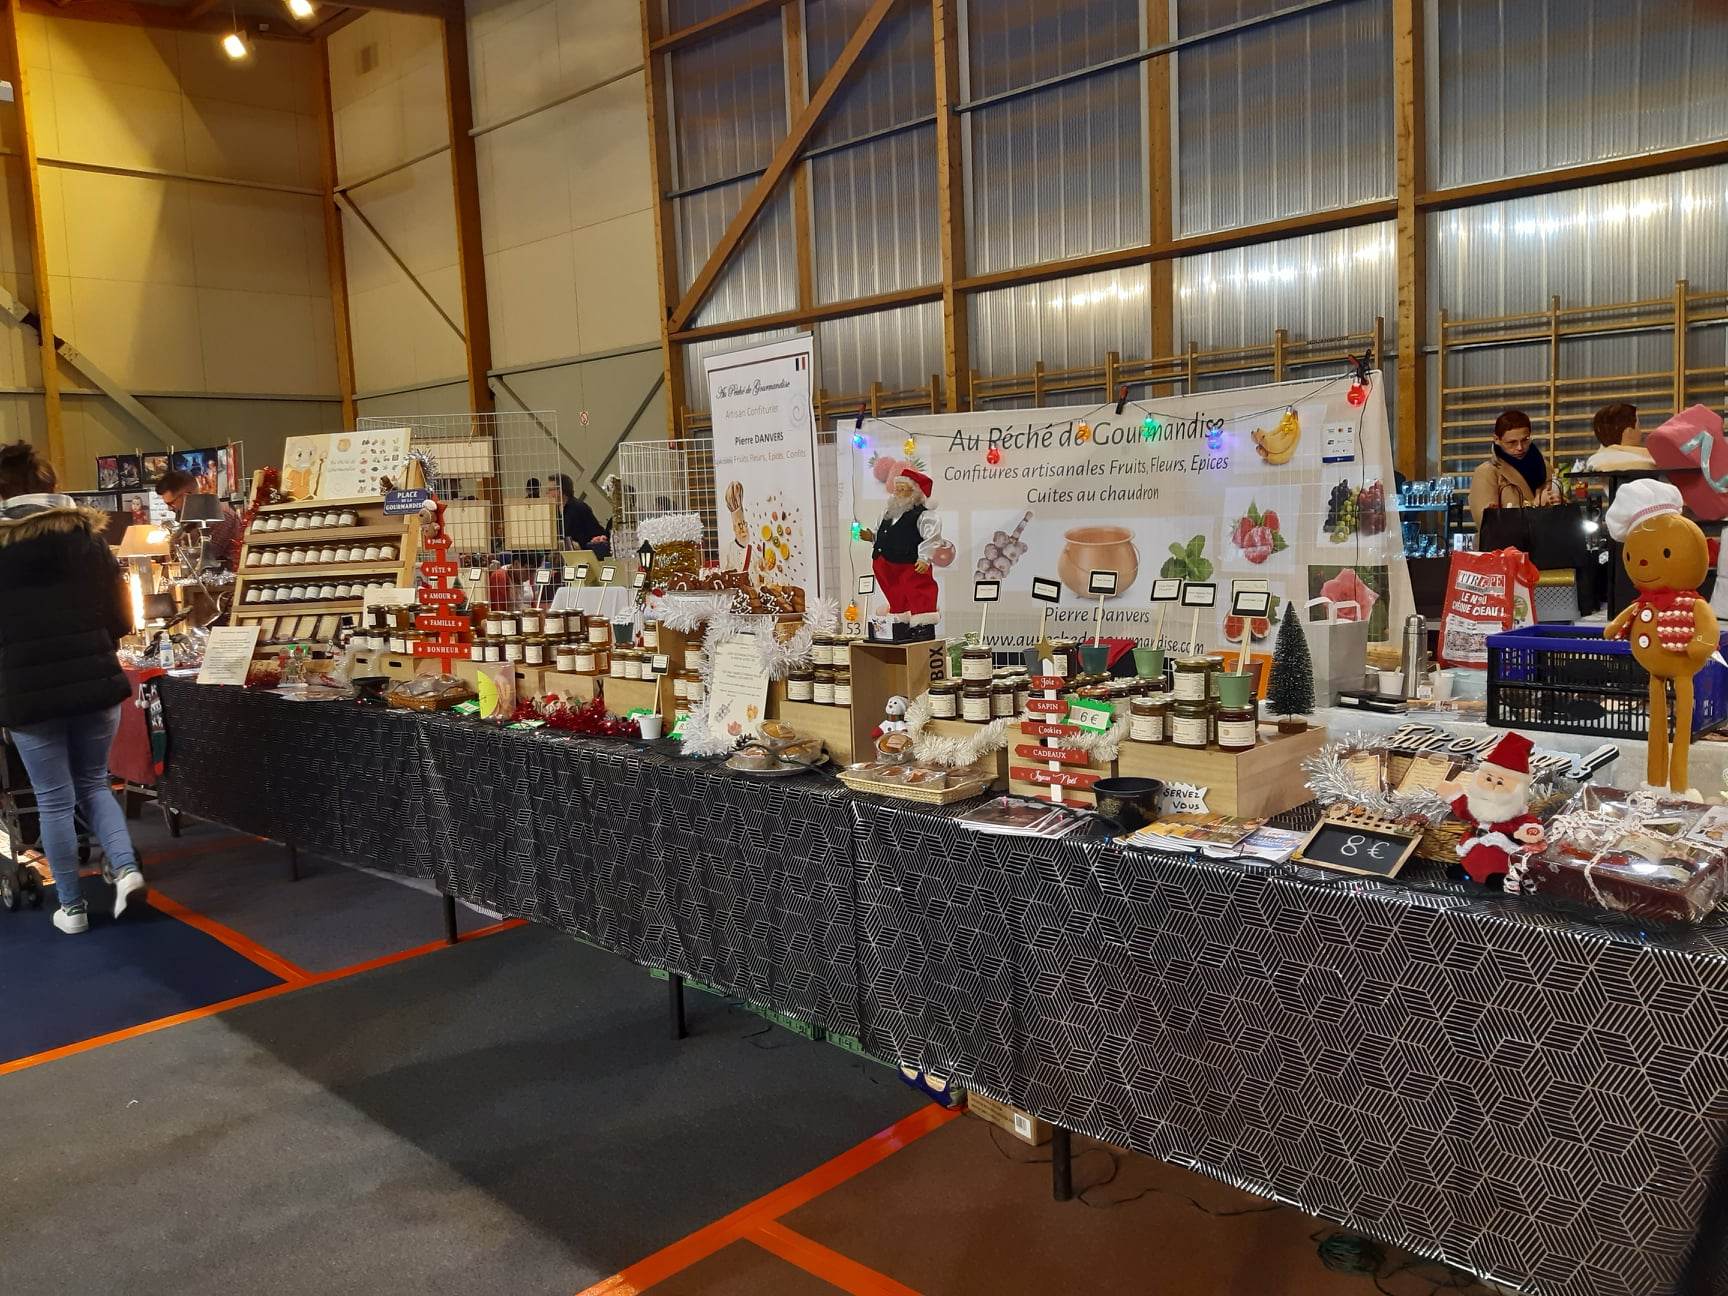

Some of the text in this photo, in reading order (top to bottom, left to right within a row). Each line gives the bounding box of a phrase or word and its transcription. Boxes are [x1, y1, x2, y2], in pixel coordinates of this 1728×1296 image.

[734, 431, 784, 446] Pierre DANVERS
[949, 412, 1225, 453] Au Péché de Gourmandise
[944, 465, 1018, 483] Confitures
[1022, 459, 1105, 480] artisanales
[1190, 453, 1229, 473] Epices
[397, 491, 418, 499] PLACE
[1027, 484, 1160, 504] Cuites au chaudron
[429, 592, 451, 600] AMOUR
[1461, 591, 1470, 602] LE
[1045, 606, 1150, 623] Pierre Danvers
[430, 619, 456, 627] FAMILLE
[846, 622, 861, 635] 53
[427, 646, 459, 654] BONHEUR
[930, 646, 945, 681] BOX
[1080, 711, 1100, 725] 6 €
[1038, 725, 1062, 735] Cookies
[1033, 749, 1066, 759] CADEAUX
[1448, 732, 1573, 770] Mon
[1163, 787, 1201, 799] SERVEZ
[1173, 801, 1201, 811] VOUS
[1340, 835, 1390, 859] 8 €
